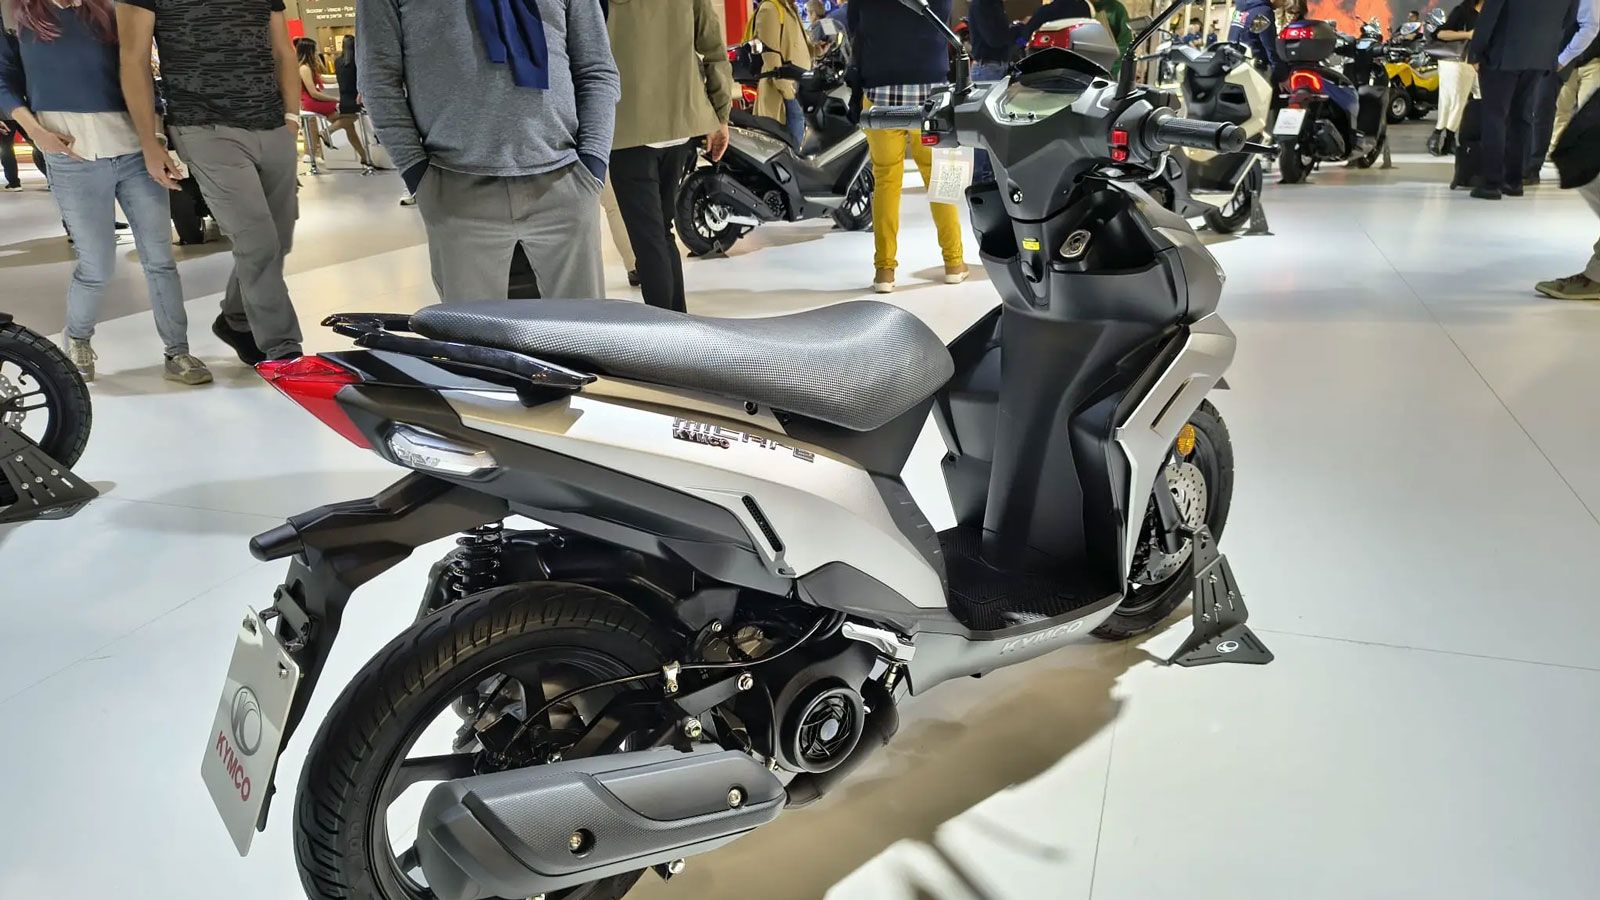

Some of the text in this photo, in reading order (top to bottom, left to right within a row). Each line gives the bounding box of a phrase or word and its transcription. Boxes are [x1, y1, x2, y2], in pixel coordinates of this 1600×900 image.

[672, 428, 731, 449] KYMCO
[1000, 620, 1084, 655] KYMCO
[216, 731, 251, 802] KYMCO
